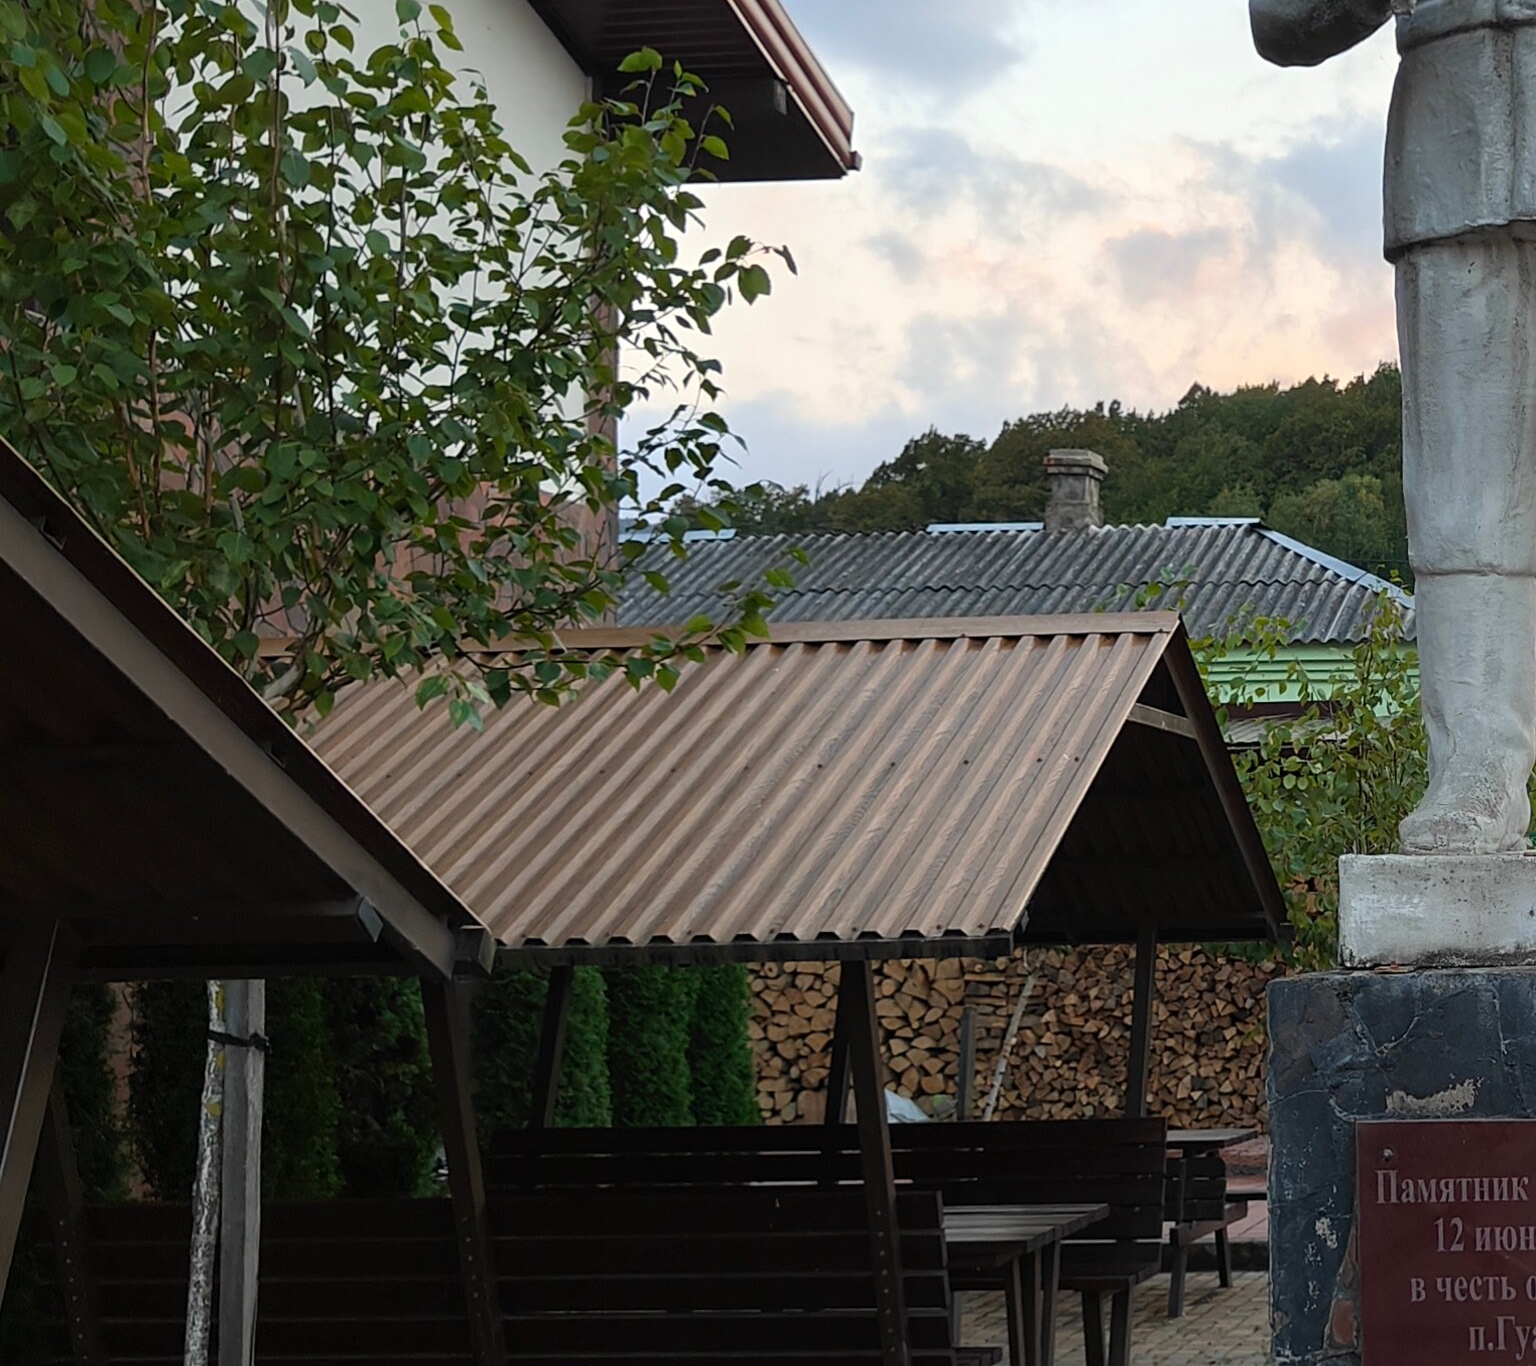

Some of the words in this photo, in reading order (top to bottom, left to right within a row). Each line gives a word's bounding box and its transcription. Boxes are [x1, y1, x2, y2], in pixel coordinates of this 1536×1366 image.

[1375, 1170, 1529, 1204] Памятник
[1433, 1216, 1464, 1252] 12
[1410, 1278, 1426, 1302] в
[1436, 1276, 1517, 1302] честь
